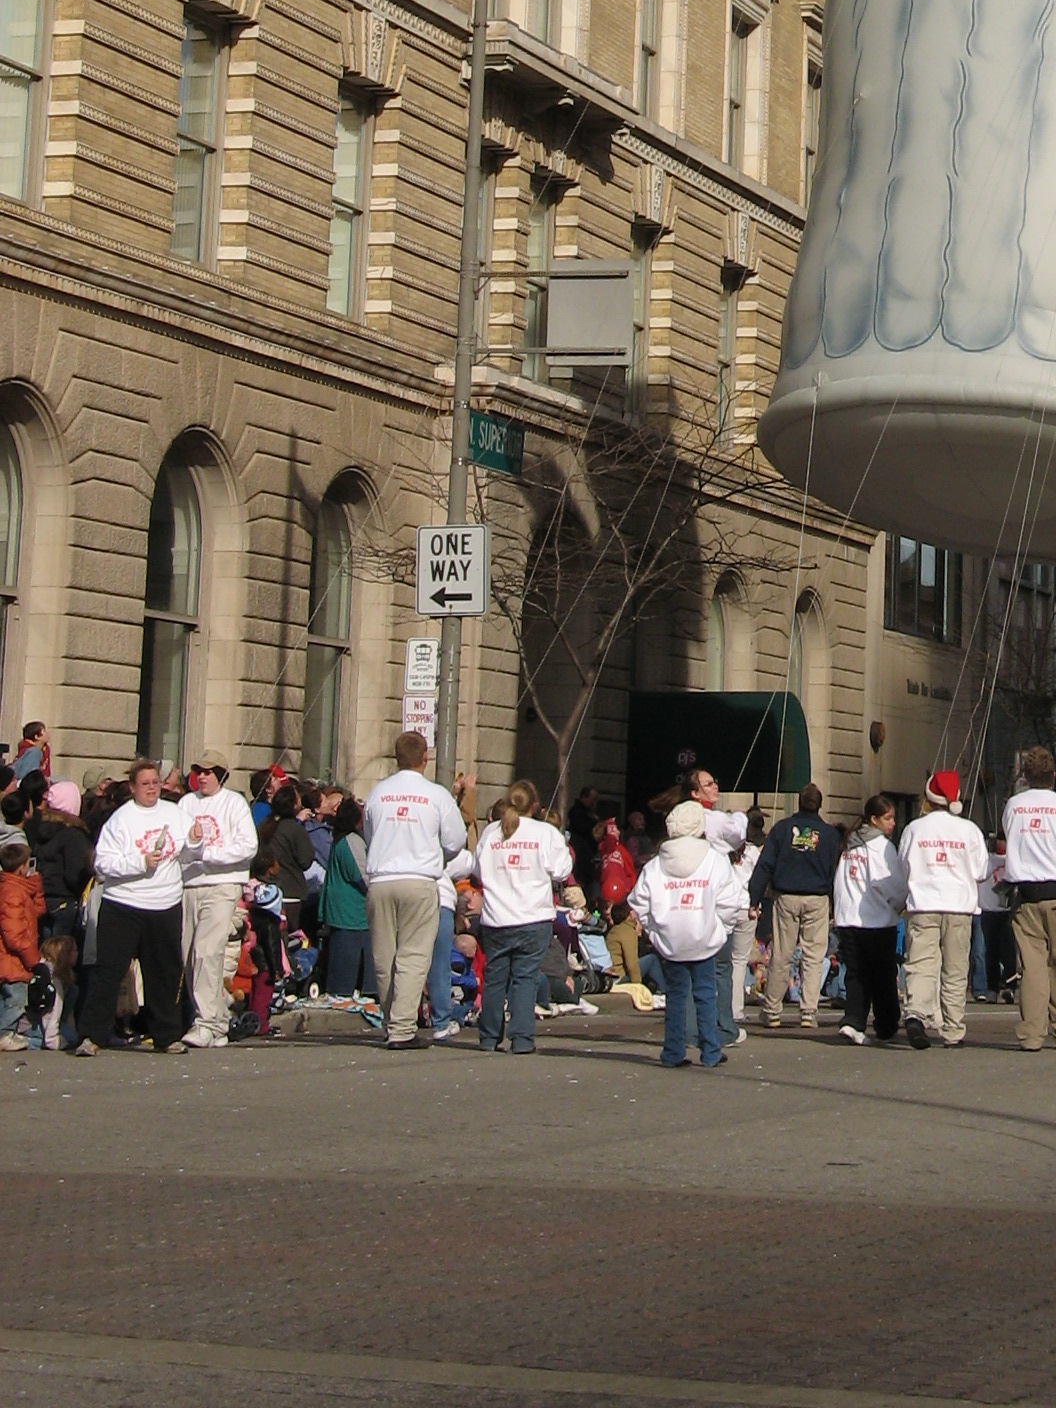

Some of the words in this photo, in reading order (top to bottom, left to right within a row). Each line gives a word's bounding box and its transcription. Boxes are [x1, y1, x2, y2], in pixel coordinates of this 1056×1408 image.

[478, 420, 523, 459] SUPERIOR
[430, 533, 472, 557] ONE
[429, 559, 471, 582] WAY
[413, 700, 426, 710] NO
[406, 713, 434, 723] STOPPING
[380, 794, 429, 805] VOLUNTEER
[490, 841, 539, 850] VOLUNTEER
[917, 840, 965, 850] VOLUNTEER
